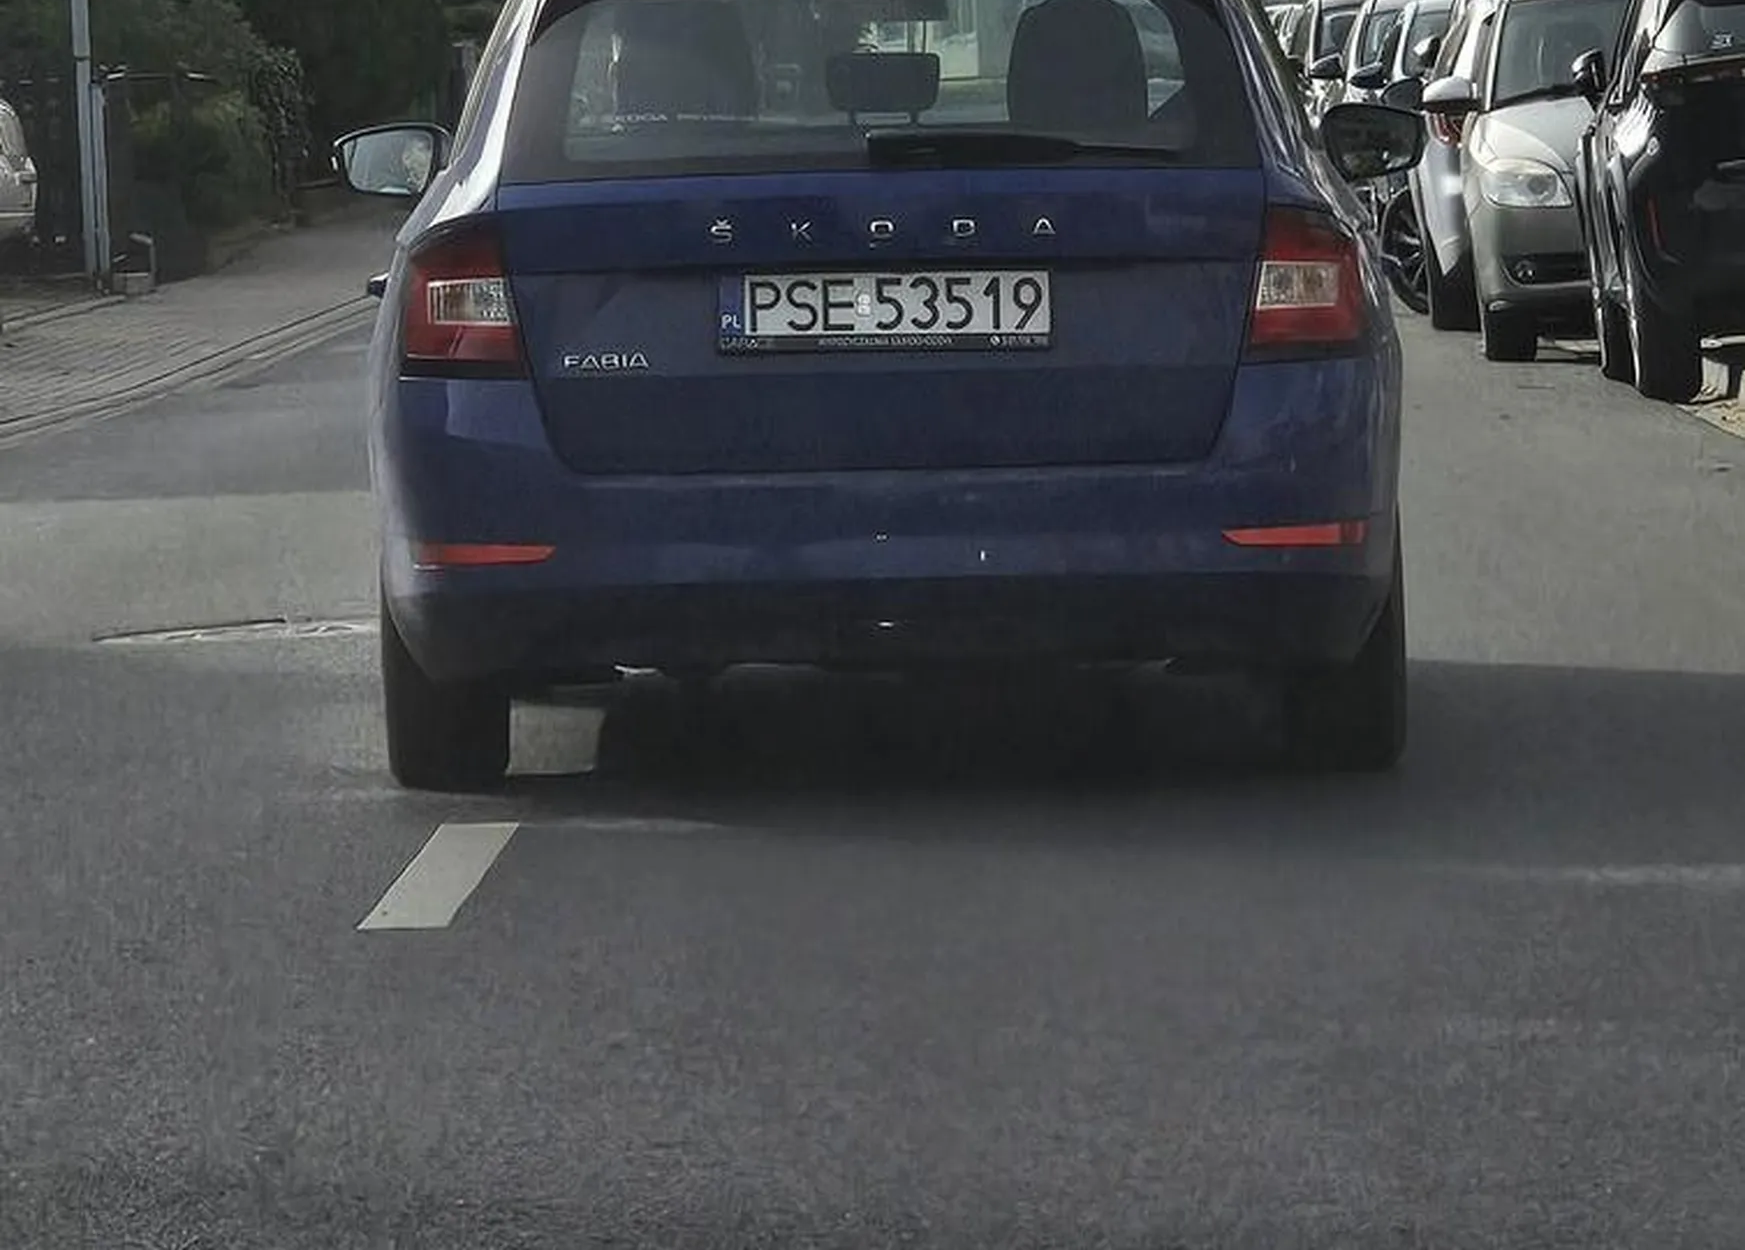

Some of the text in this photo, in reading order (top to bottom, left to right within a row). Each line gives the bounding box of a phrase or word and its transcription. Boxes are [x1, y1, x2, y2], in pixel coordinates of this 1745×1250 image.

[749, 276, 1044, 333] PSE 53519
[721, 314, 741, 329] PL
[563, 353, 650, 370] FABIA
